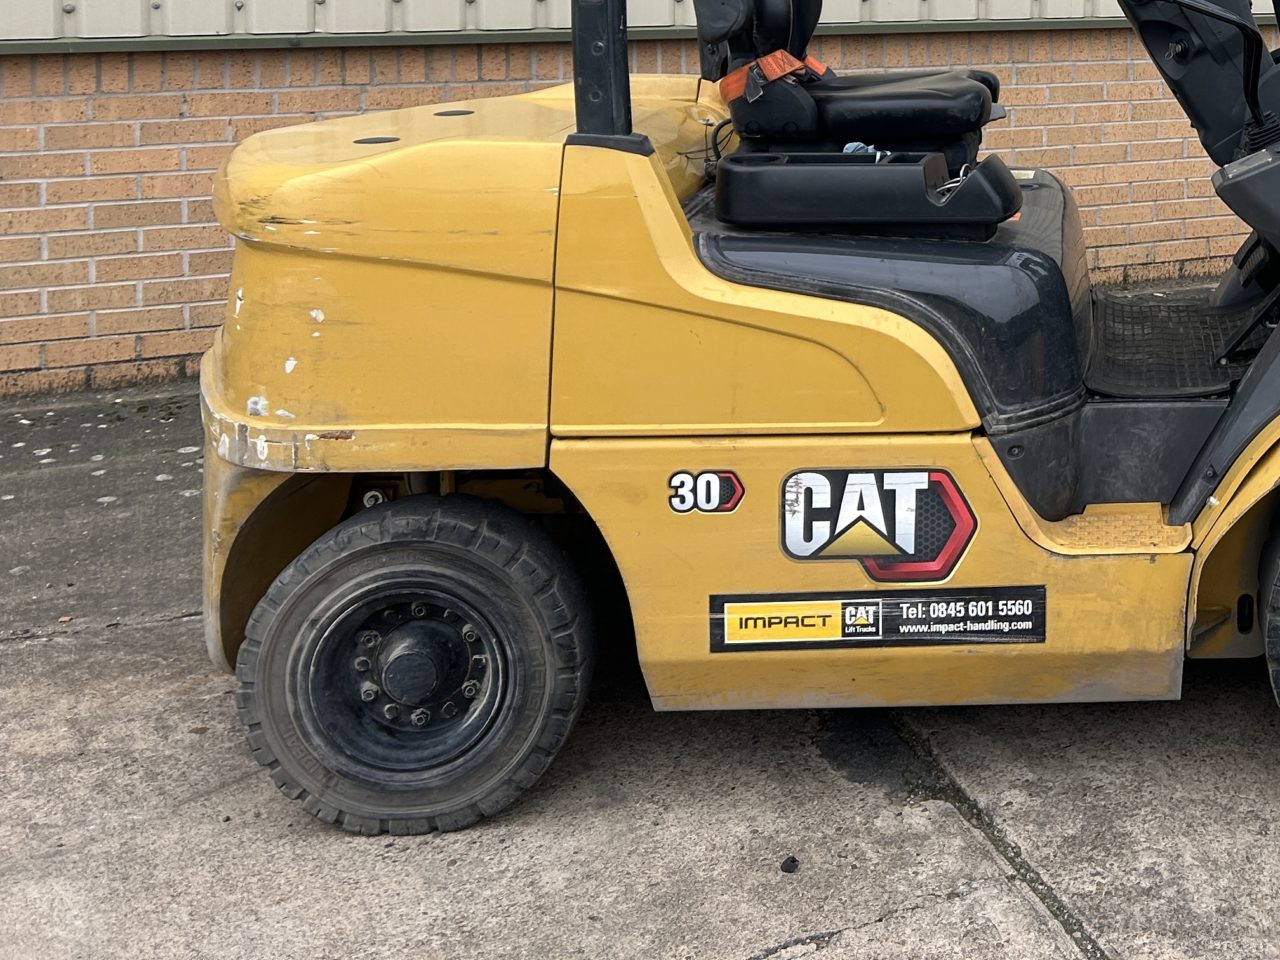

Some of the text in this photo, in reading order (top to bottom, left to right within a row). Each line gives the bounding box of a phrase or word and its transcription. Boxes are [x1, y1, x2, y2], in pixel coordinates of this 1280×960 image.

[670, 473, 720, 510] 30
[785, 472, 929, 556] CAT
[845, 606, 877, 625] CAT
[900, 600, 1032, 619] Tel: 0845 601 5560
[739, 614, 832, 629] IMPACT
[856, 625, 876, 633] Trucks
[899, 620, 1032, 634] www.impact-handling.com
